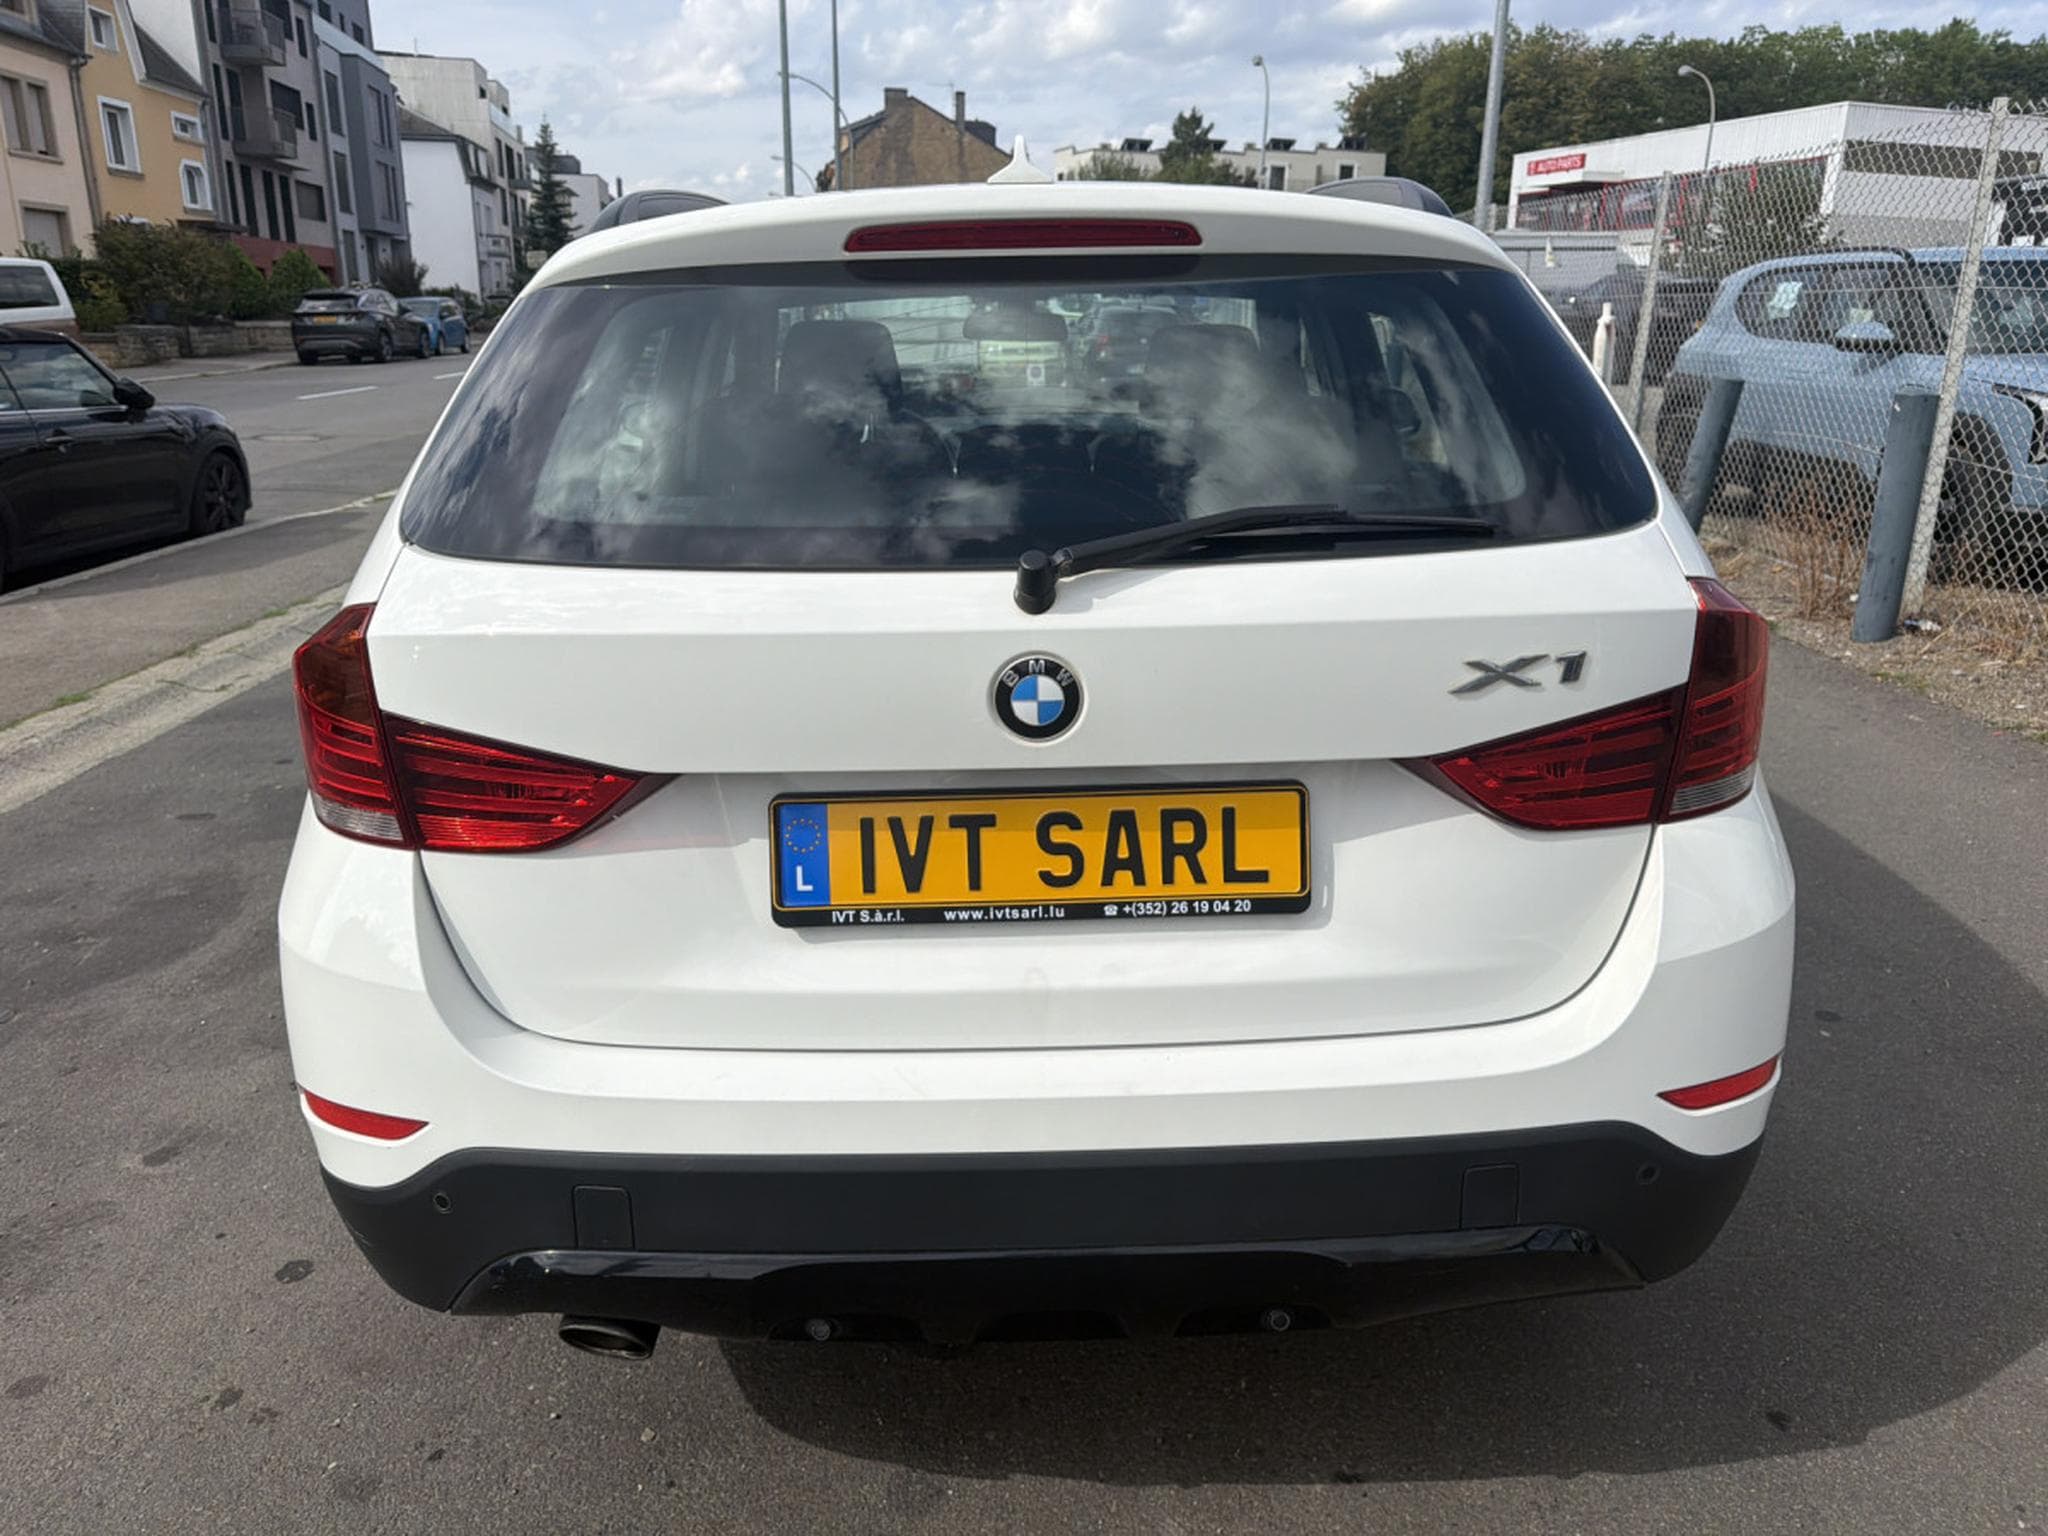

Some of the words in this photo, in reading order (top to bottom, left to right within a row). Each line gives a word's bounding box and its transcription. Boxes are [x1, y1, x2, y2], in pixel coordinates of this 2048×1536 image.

[1003, 660, 1074, 687] BMW
[1447, 651, 1587, 694] X1
[859, 814, 997, 894] IVT
[1035, 806, 1269, 888] SARL
[796, 865, 813, 891] L
[832, 910, 854, 923] IVT
[943, 905, 1065, 921] www.ivtsarl.lu
[1122, 901, 1167, 917] +(352)
[1171, 900, 1188, 914] 26
[1193, 900, 1209, 913] 19
[1213, 900, 1230, 913] 04
[1234, 899, 1251, 912] 20
